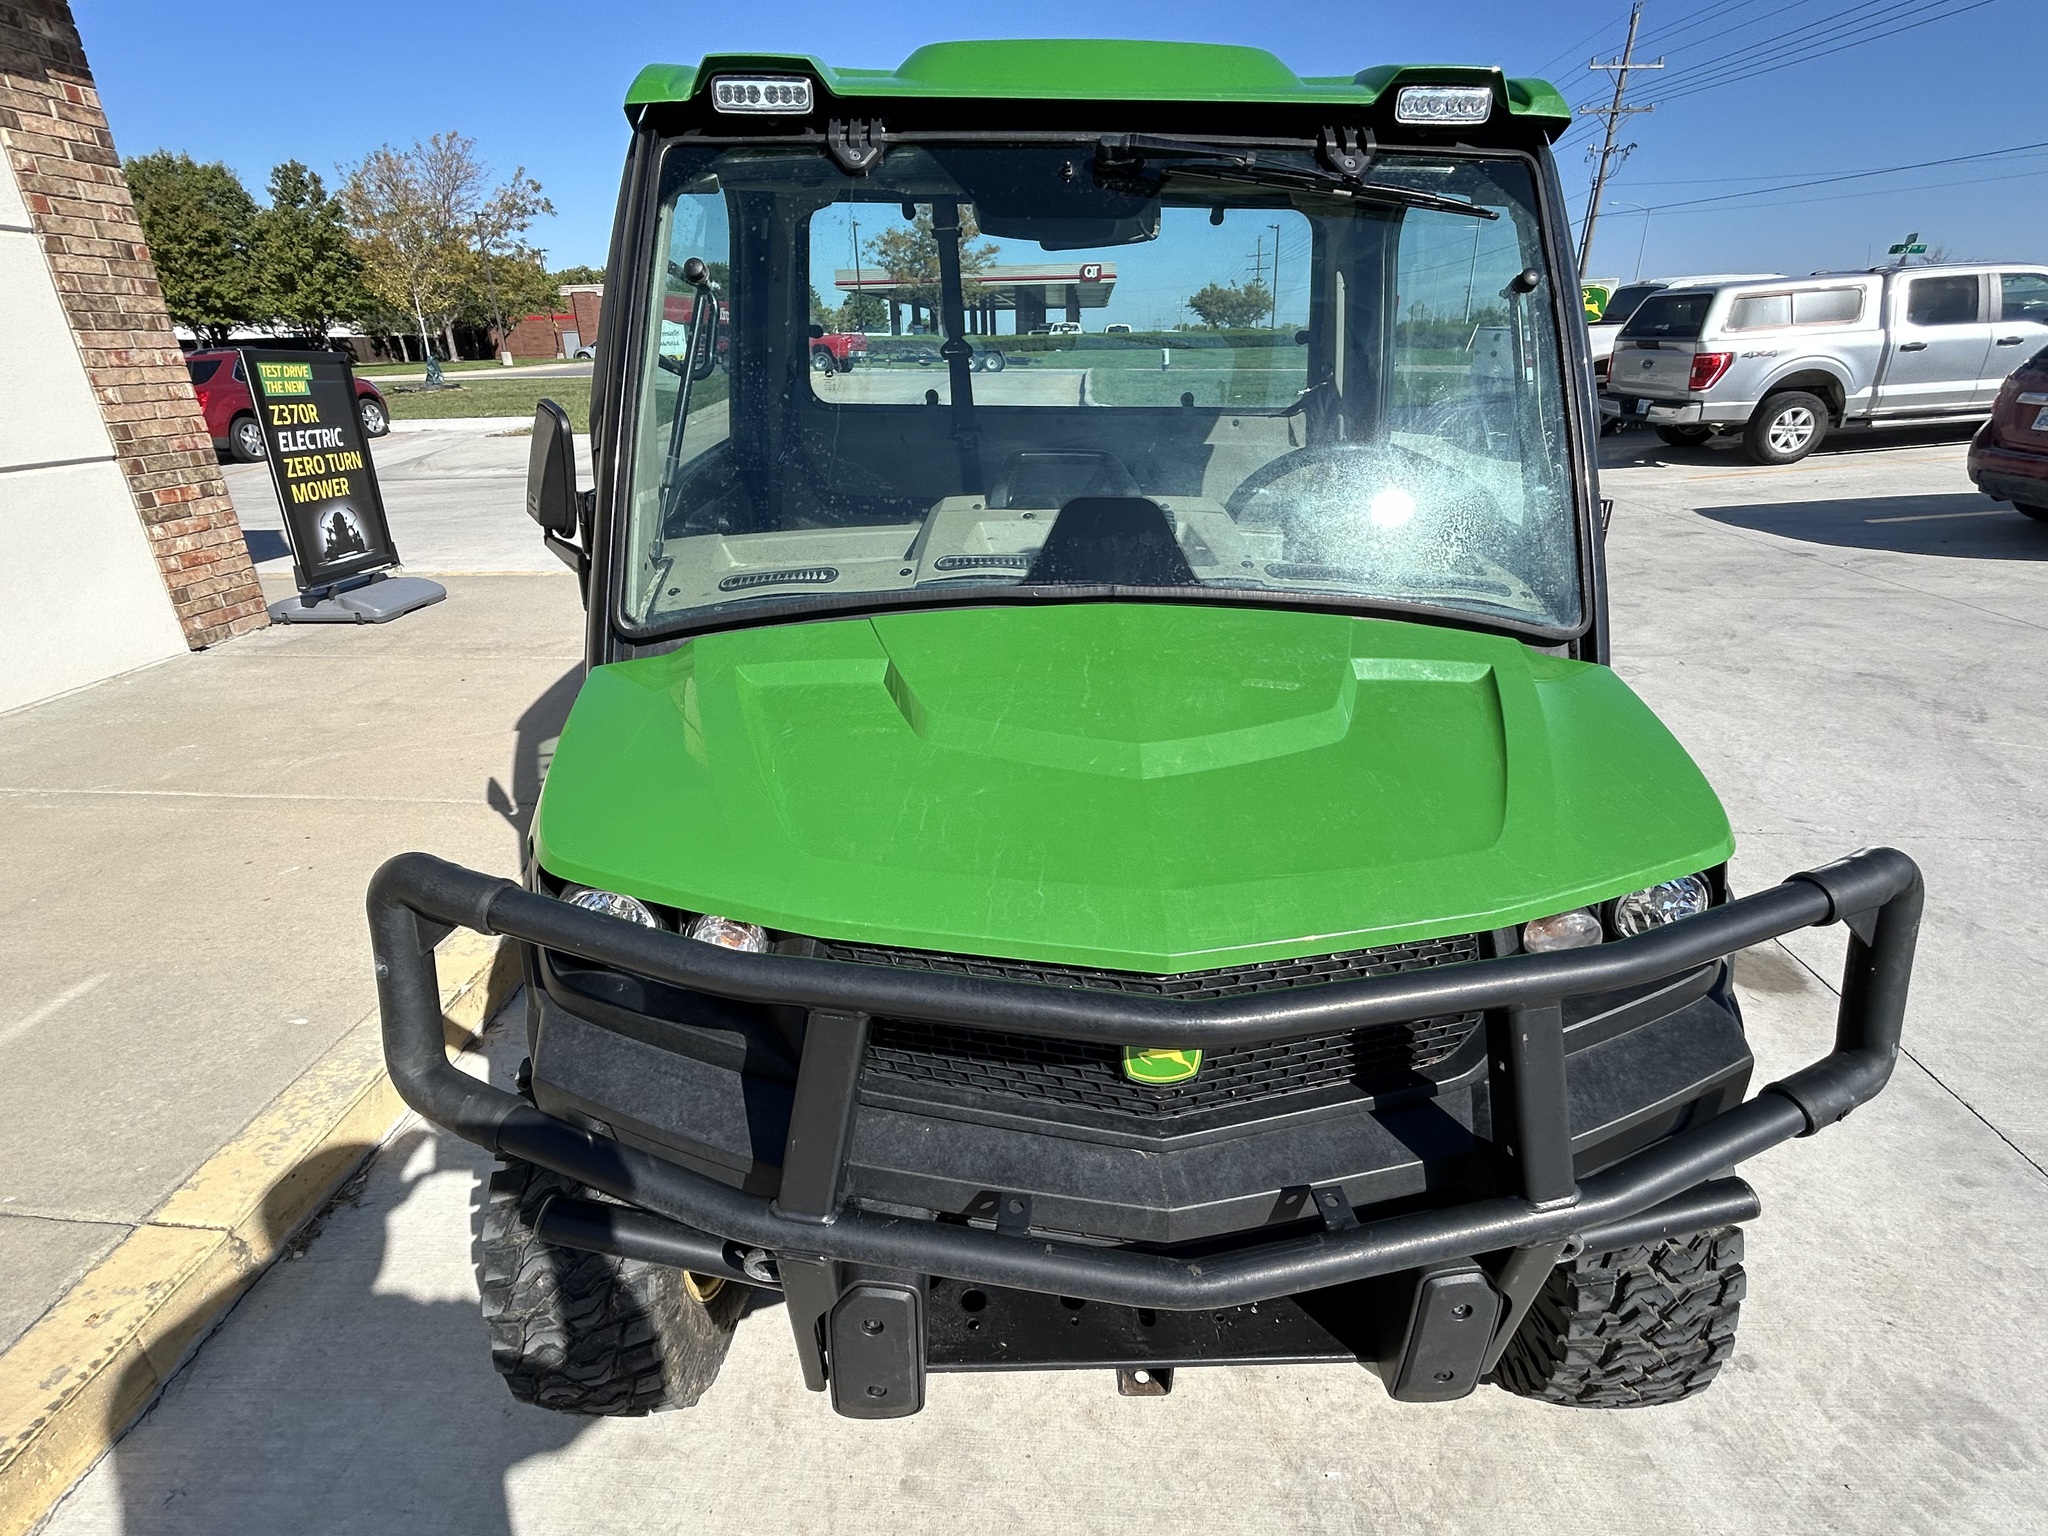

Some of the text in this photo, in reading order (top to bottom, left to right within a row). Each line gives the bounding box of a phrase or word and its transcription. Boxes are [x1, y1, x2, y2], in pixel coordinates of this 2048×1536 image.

[1084, 265, 1100, 279] QT
[260, 365, 309, 378] TEST DRIVE
[265, 381, 306, 393] THE NEW
[268, 404, 320, 425] Z370R
[278, 428, 344, 452] ELECTRIC
[283, 451, 363, 477] ZERO TURN
[290, 477, 350, 503] MOWER
